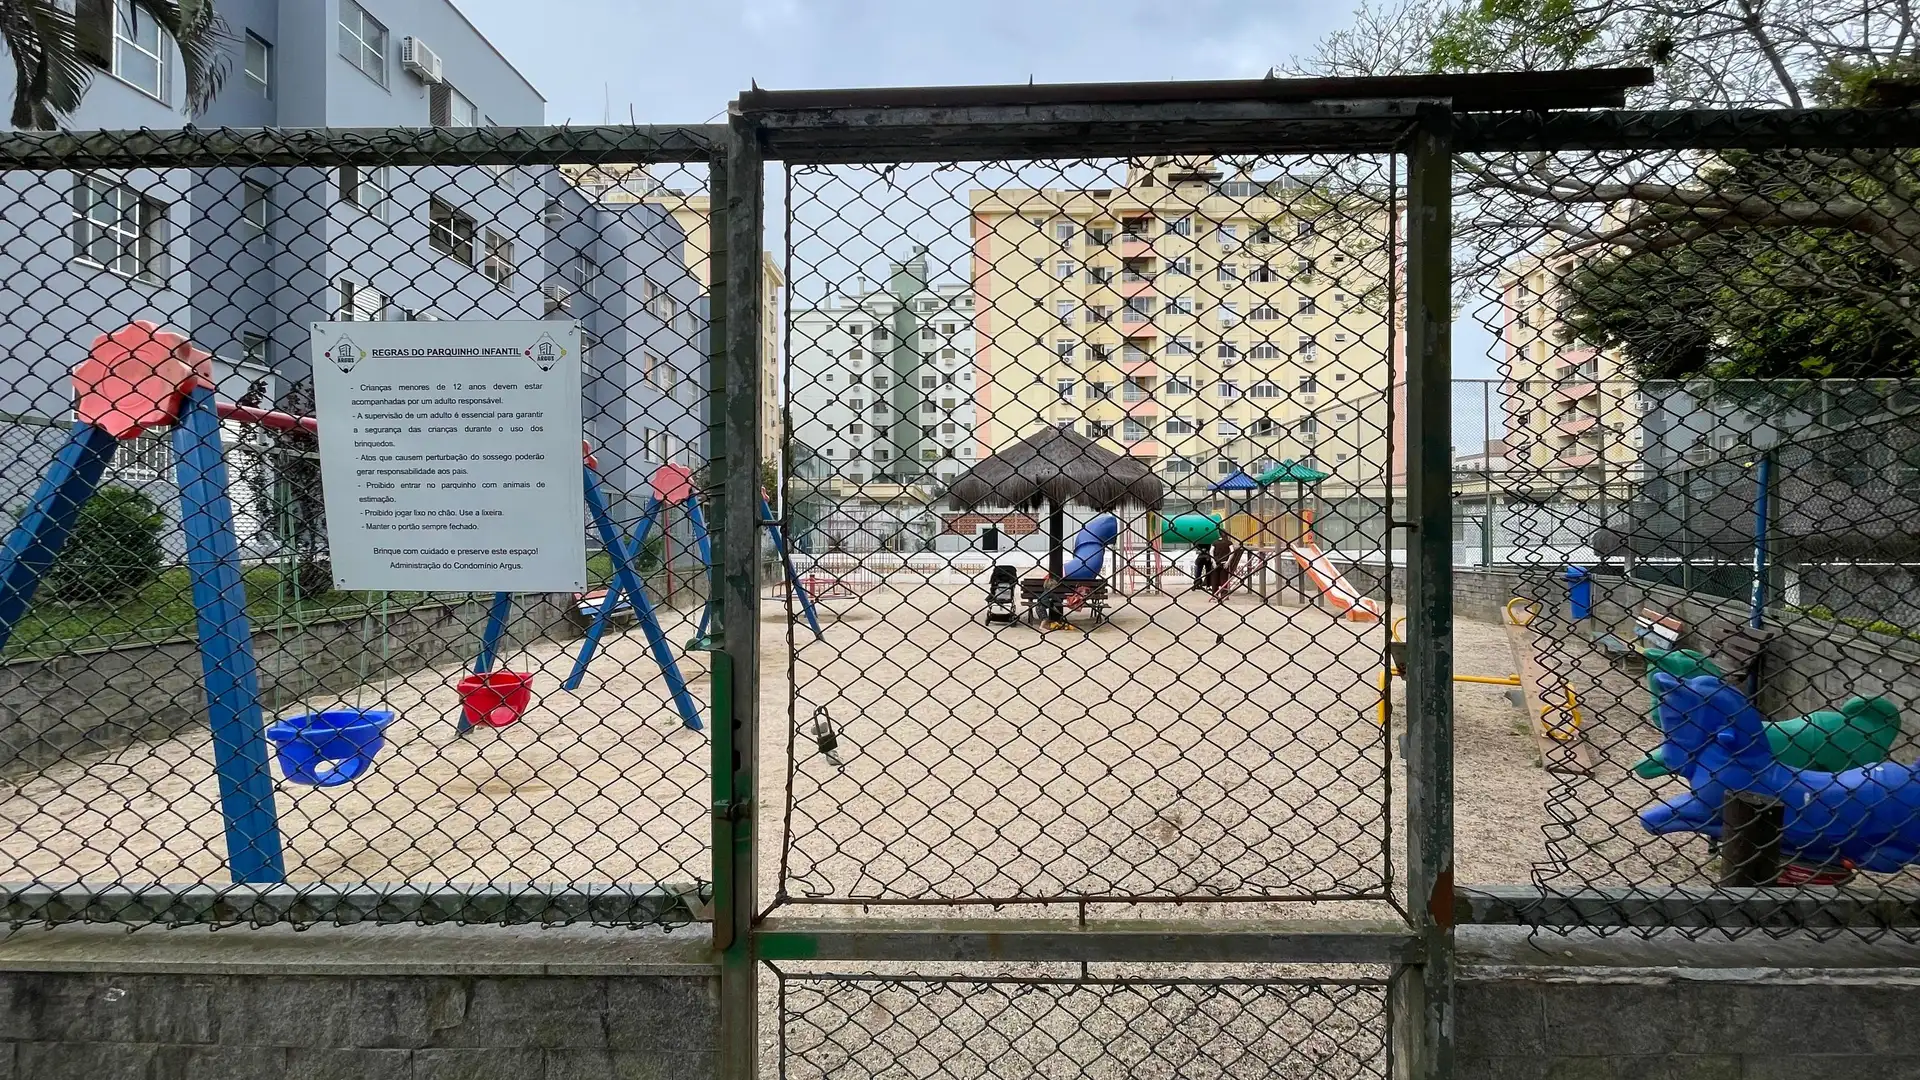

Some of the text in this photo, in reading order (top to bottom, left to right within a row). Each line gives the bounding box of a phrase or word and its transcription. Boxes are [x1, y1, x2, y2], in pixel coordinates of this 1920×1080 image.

[372, 347, 522, 356] REGRAS DO PARQUINHO INFANTIL
[360, 384, 392, 393] Crianças
[351, 398, 406, 406] acompanhadas
[457, 397, 504, 406] responsável.
[364, 412, 404, 420] supervisão
[515, 411, 543, 420] garantir
[354, 440, 395, 448] brinquedos.
[425, 453, 468, 462] perturbação
[514, 453, 545, 461] poderão
[376, 467, 436, 476] responsabilidade
[451, 468, 468, 476] pais.
[441, 481, 477, 490] parquinho
[359, 495, 397, 504] estimação.
[397, 523, 420, 531] portão
[373, 547, 402, 556] Brinque
[509, 548, 539, 556] espaço!
[390, 561, 442, 570] Administração
[453, 561, 499, 570] Condomínio
[499, 562, 523, 571] Argus.
